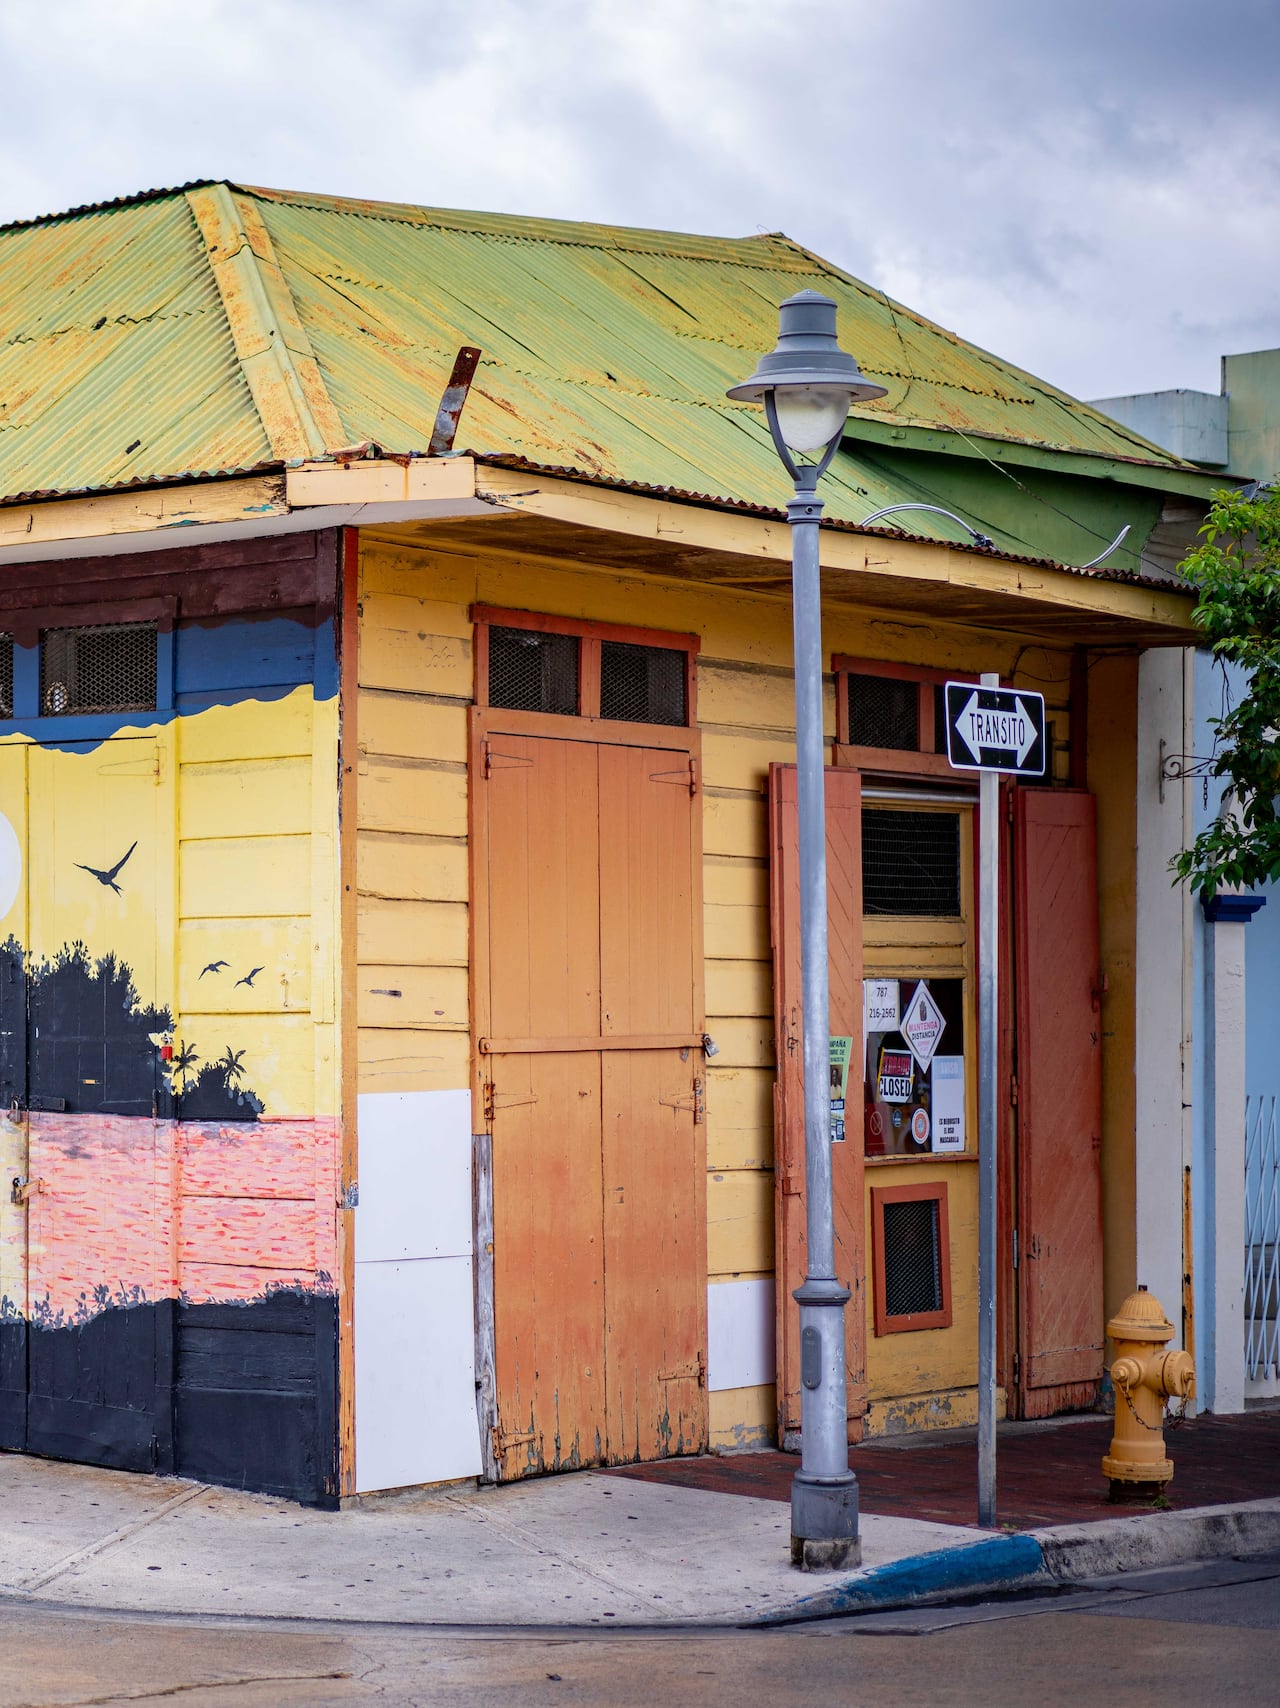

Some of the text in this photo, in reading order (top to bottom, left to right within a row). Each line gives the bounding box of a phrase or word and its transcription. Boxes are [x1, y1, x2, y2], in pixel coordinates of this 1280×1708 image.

[969, 712, 1025, 747] TRANSITO
[876, 986, 888, 998] 787
[869, 1007, 896, 1019] 216-2562
[908, 1020, 938, 1033] MANTENGA
[911, 1030, 936, 1040] DISTANCIA
[880, 1077, 911, 1097] CLOSED
